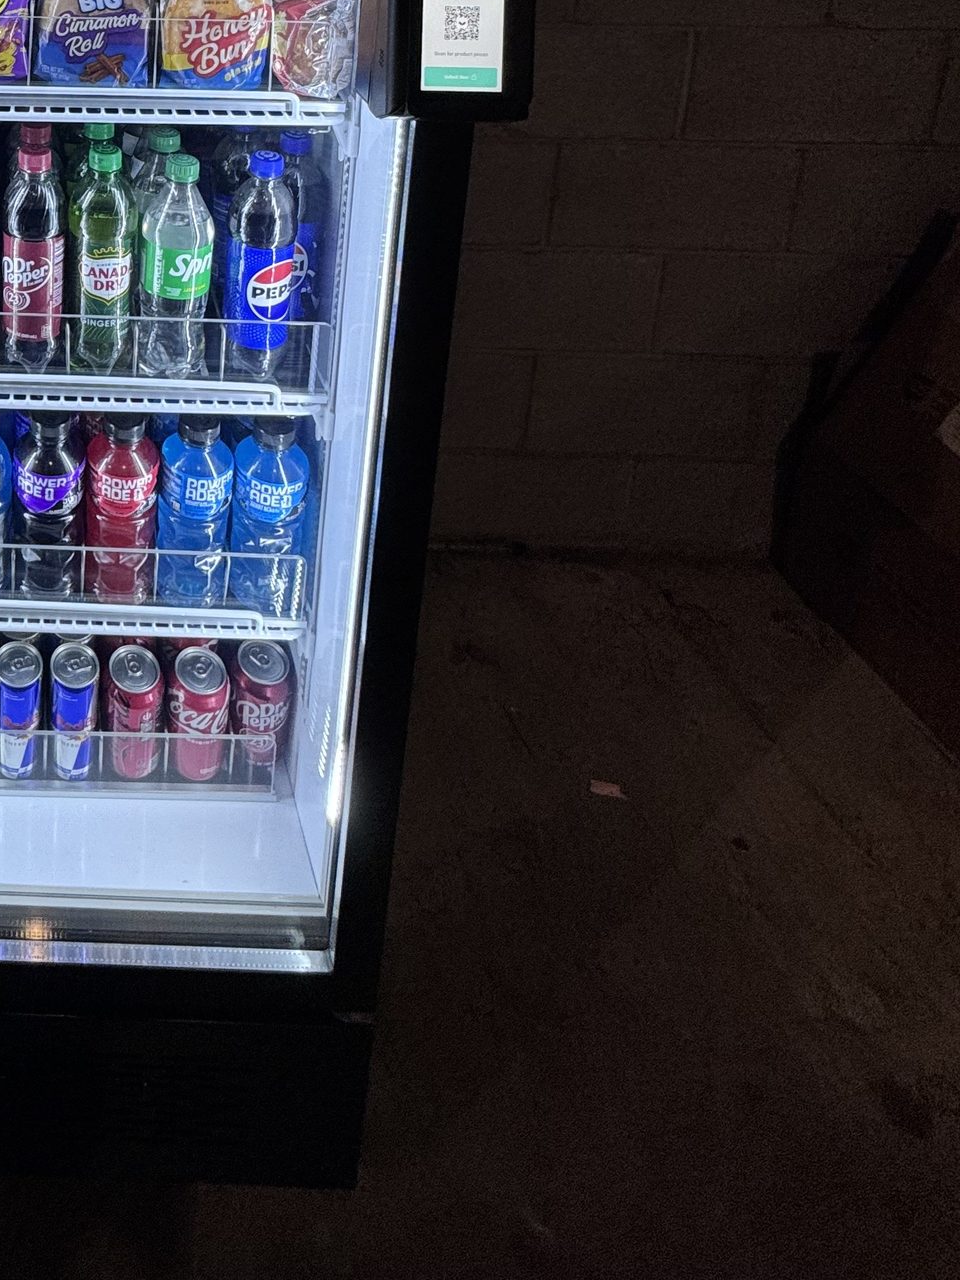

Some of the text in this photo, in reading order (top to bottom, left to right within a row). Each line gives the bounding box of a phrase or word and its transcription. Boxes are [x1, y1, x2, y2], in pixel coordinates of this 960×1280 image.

[55, 13, 139, 36] Cinnamon
[183, 7, 267, 48] Honey
[65, 32, 105, 56] Roll
[14, 258, 35, 272] Dr
[94, 279, 123, 291] DRY
[81, 318, 117, 327] GINGER
[18, 468, 65, 488] POWER
[102, 485, 130, 500] ADE
